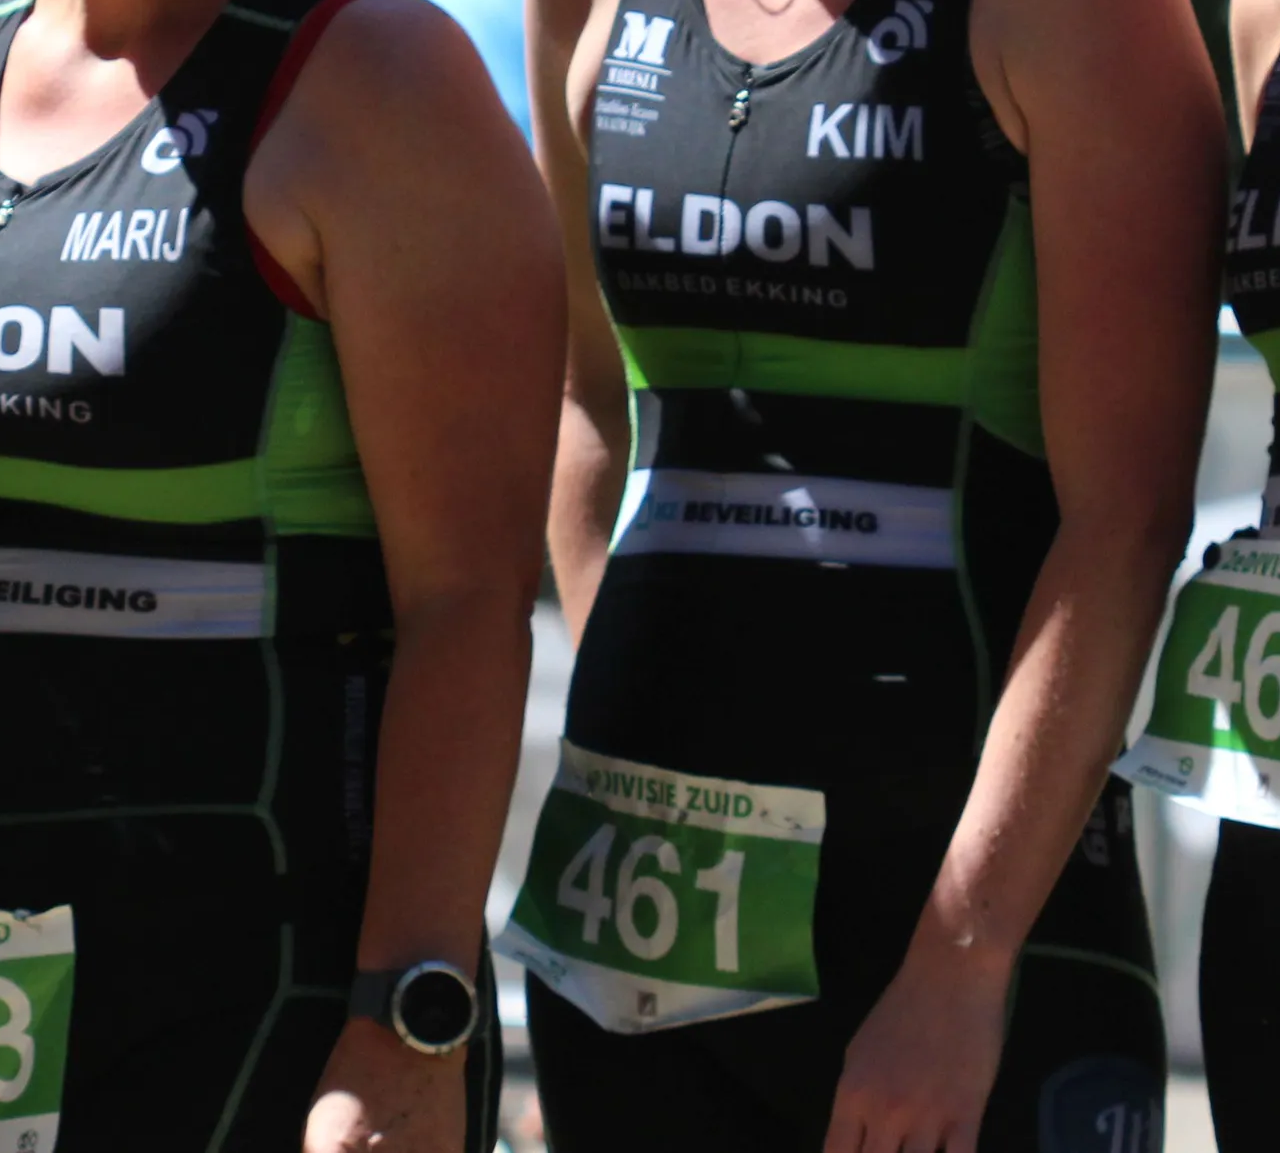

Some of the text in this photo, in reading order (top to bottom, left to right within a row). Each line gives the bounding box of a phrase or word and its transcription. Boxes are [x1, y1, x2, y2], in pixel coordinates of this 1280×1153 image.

[613, 11, 675, 65] M
[806, 103, 924, 162] KIM
[60, 207, 189, 262] MARIJ
[598, 183, 875, 271] ELDON
[683, 501, 878, 533] BEVEILIGING
[686, 785, 753, 818] ZUID
[556, 822, 746, 973] 461
